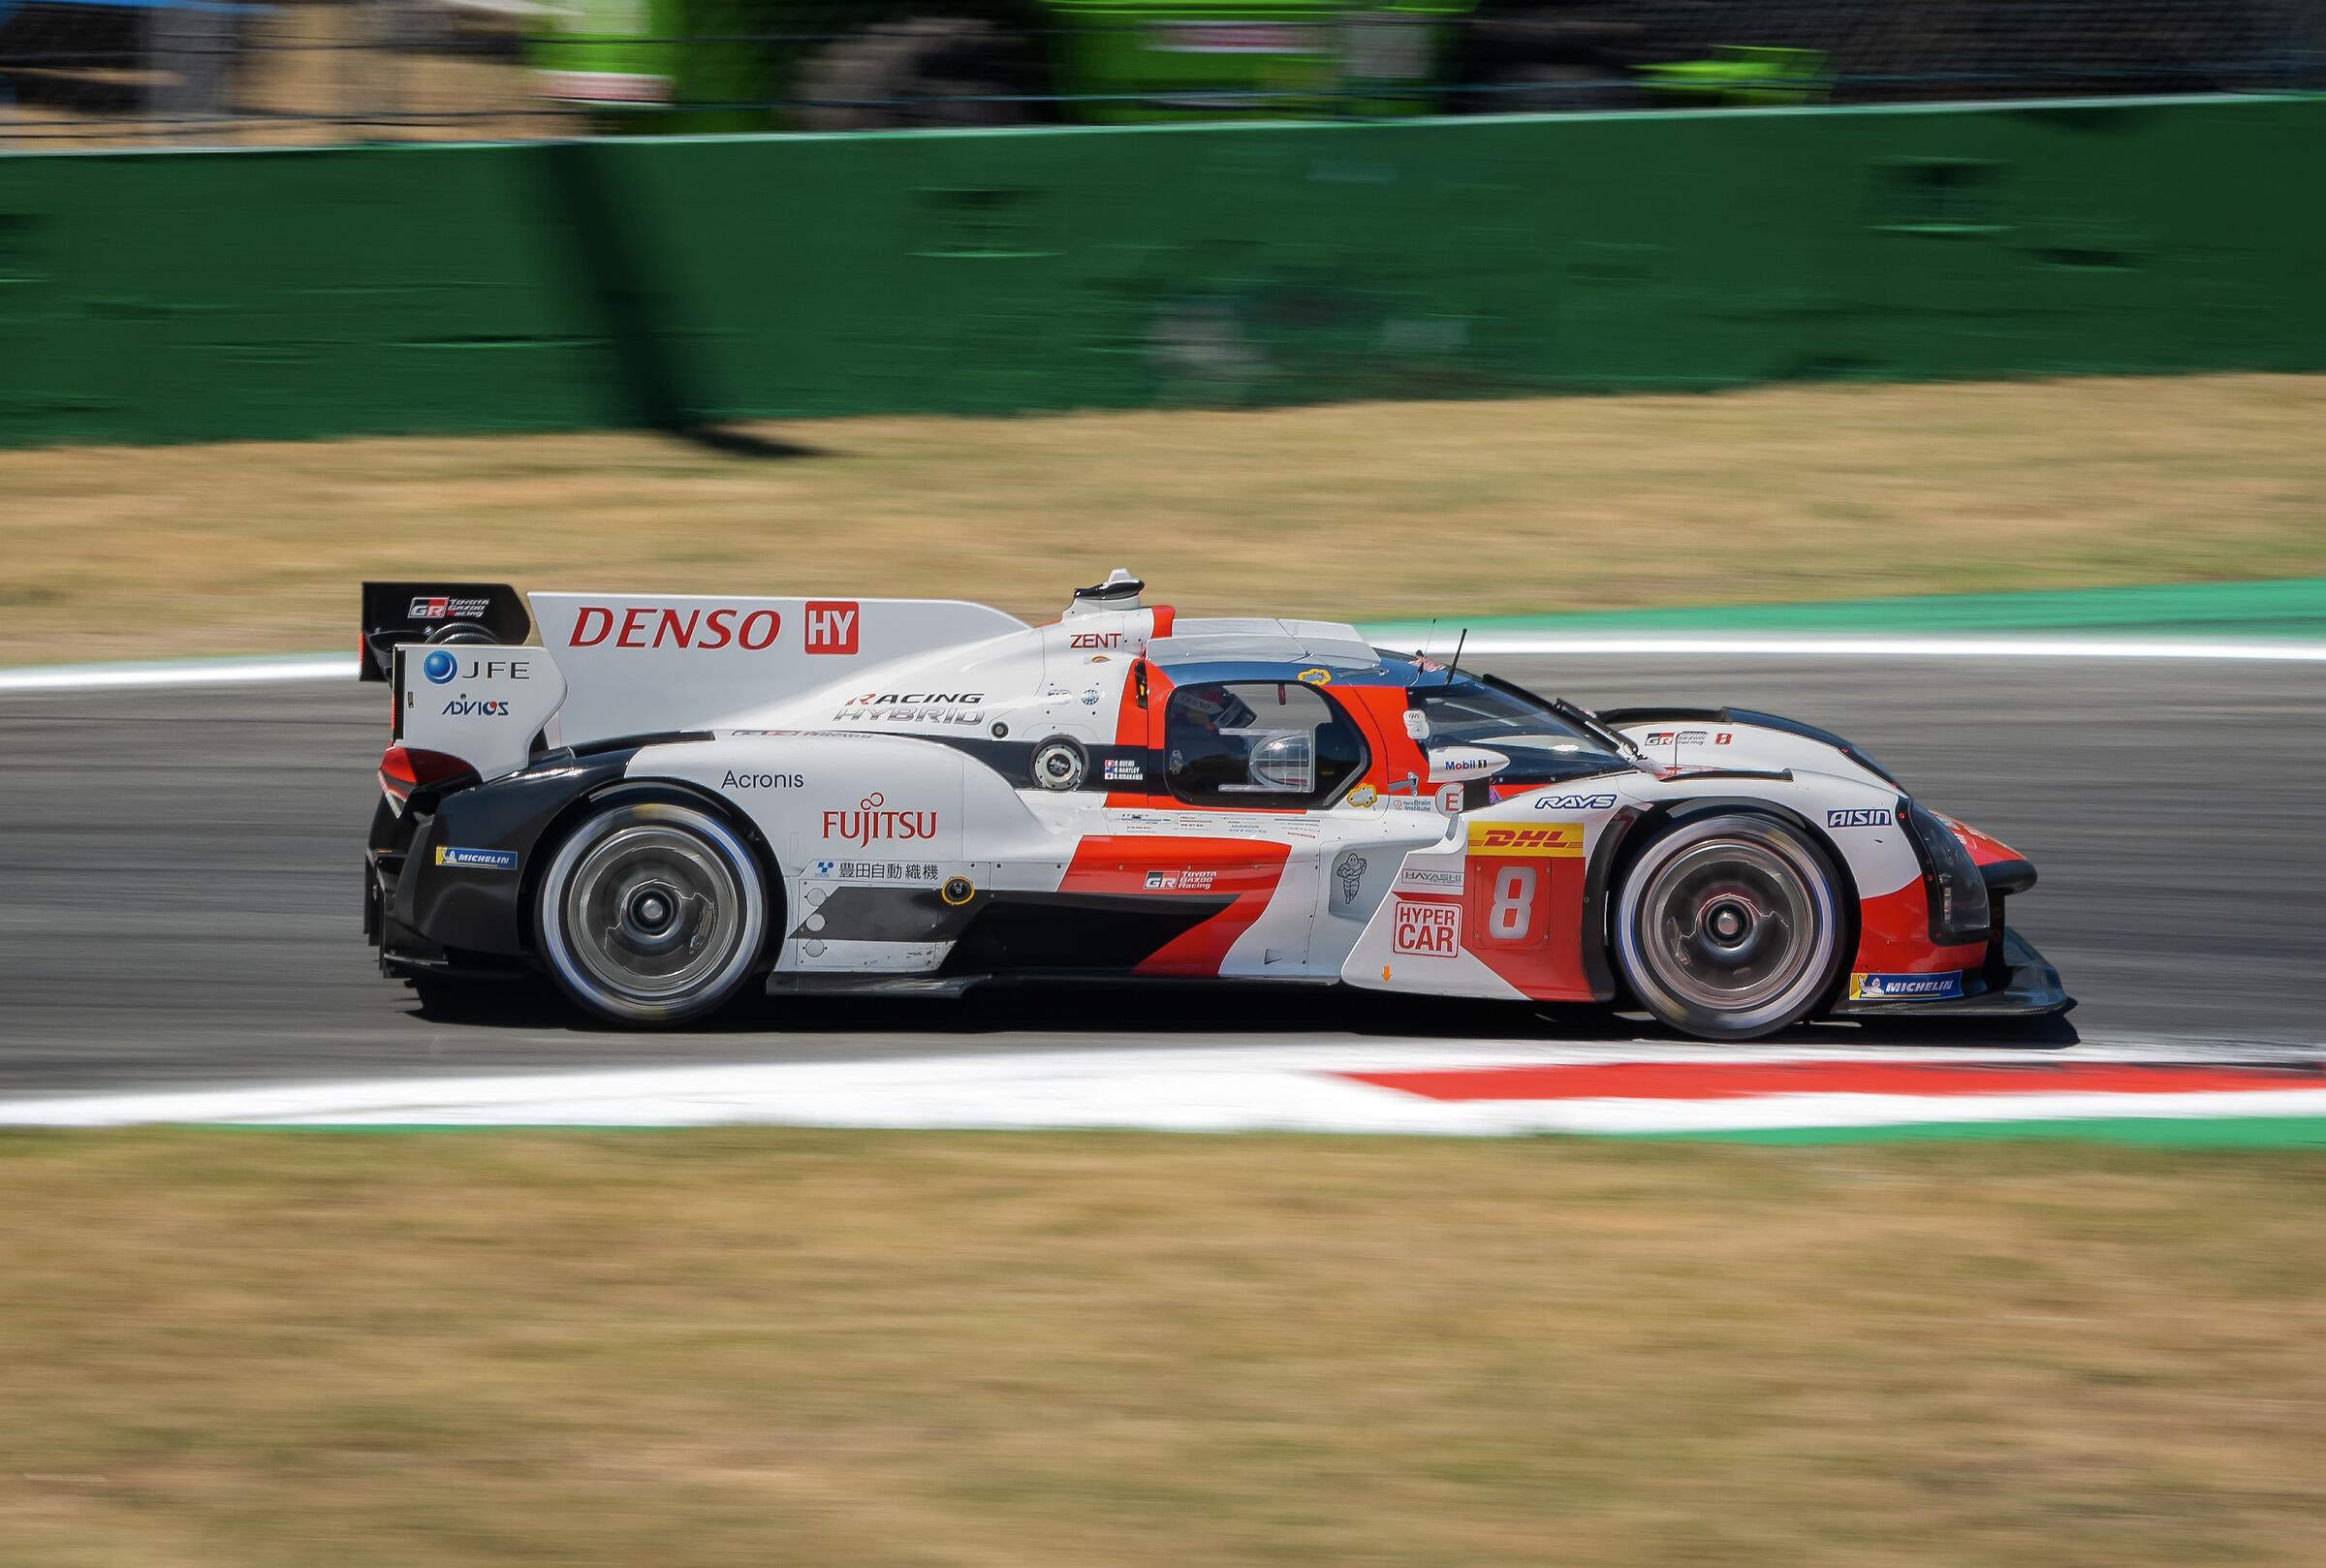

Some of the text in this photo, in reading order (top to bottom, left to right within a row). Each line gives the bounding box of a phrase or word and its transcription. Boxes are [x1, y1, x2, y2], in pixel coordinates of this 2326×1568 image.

[410, 605, 445, 616] GR
[568, 606, 781, 650] DENSO
[807, 611, 856, 645] HY
[1070, 633, 1122, 648] ZENT
[461, 661, 530, 679] JFE
[441, 701, 509, 715] ADVICS
[845, 693, 985, 706] RACING
[832, 706, 986, 726] HYBRID
[1647, 737, 1674, 745] GR
[1714, 733, 1733, 744] 8
[1445, 759, 1488, 770] Mobil 1
[720, 770, 803, 790] Acronis
[1444, 793, 1460, 812] E
[1535, 794, 1618, 809] RAYS
[1829, 810, 1890, 827] AISIN
[822, 810, 937, 848] FUJITSU
[1483, 830, 1568, 848] DHL
[457, 853, 510, 864] MICHELIN
[838, 862, 939, 880] 豊田自動織機
[1405, 871, 1462, 881] HAYASHI
[1145, 877, 1177, 889] GR
[1488, 866, 1537, 940] 8
[1399, 906, 1456, 926] HYPER
[1398, 924, 1454, 952] CAR
[1885, 980, 1954, 992] MICHELIN
